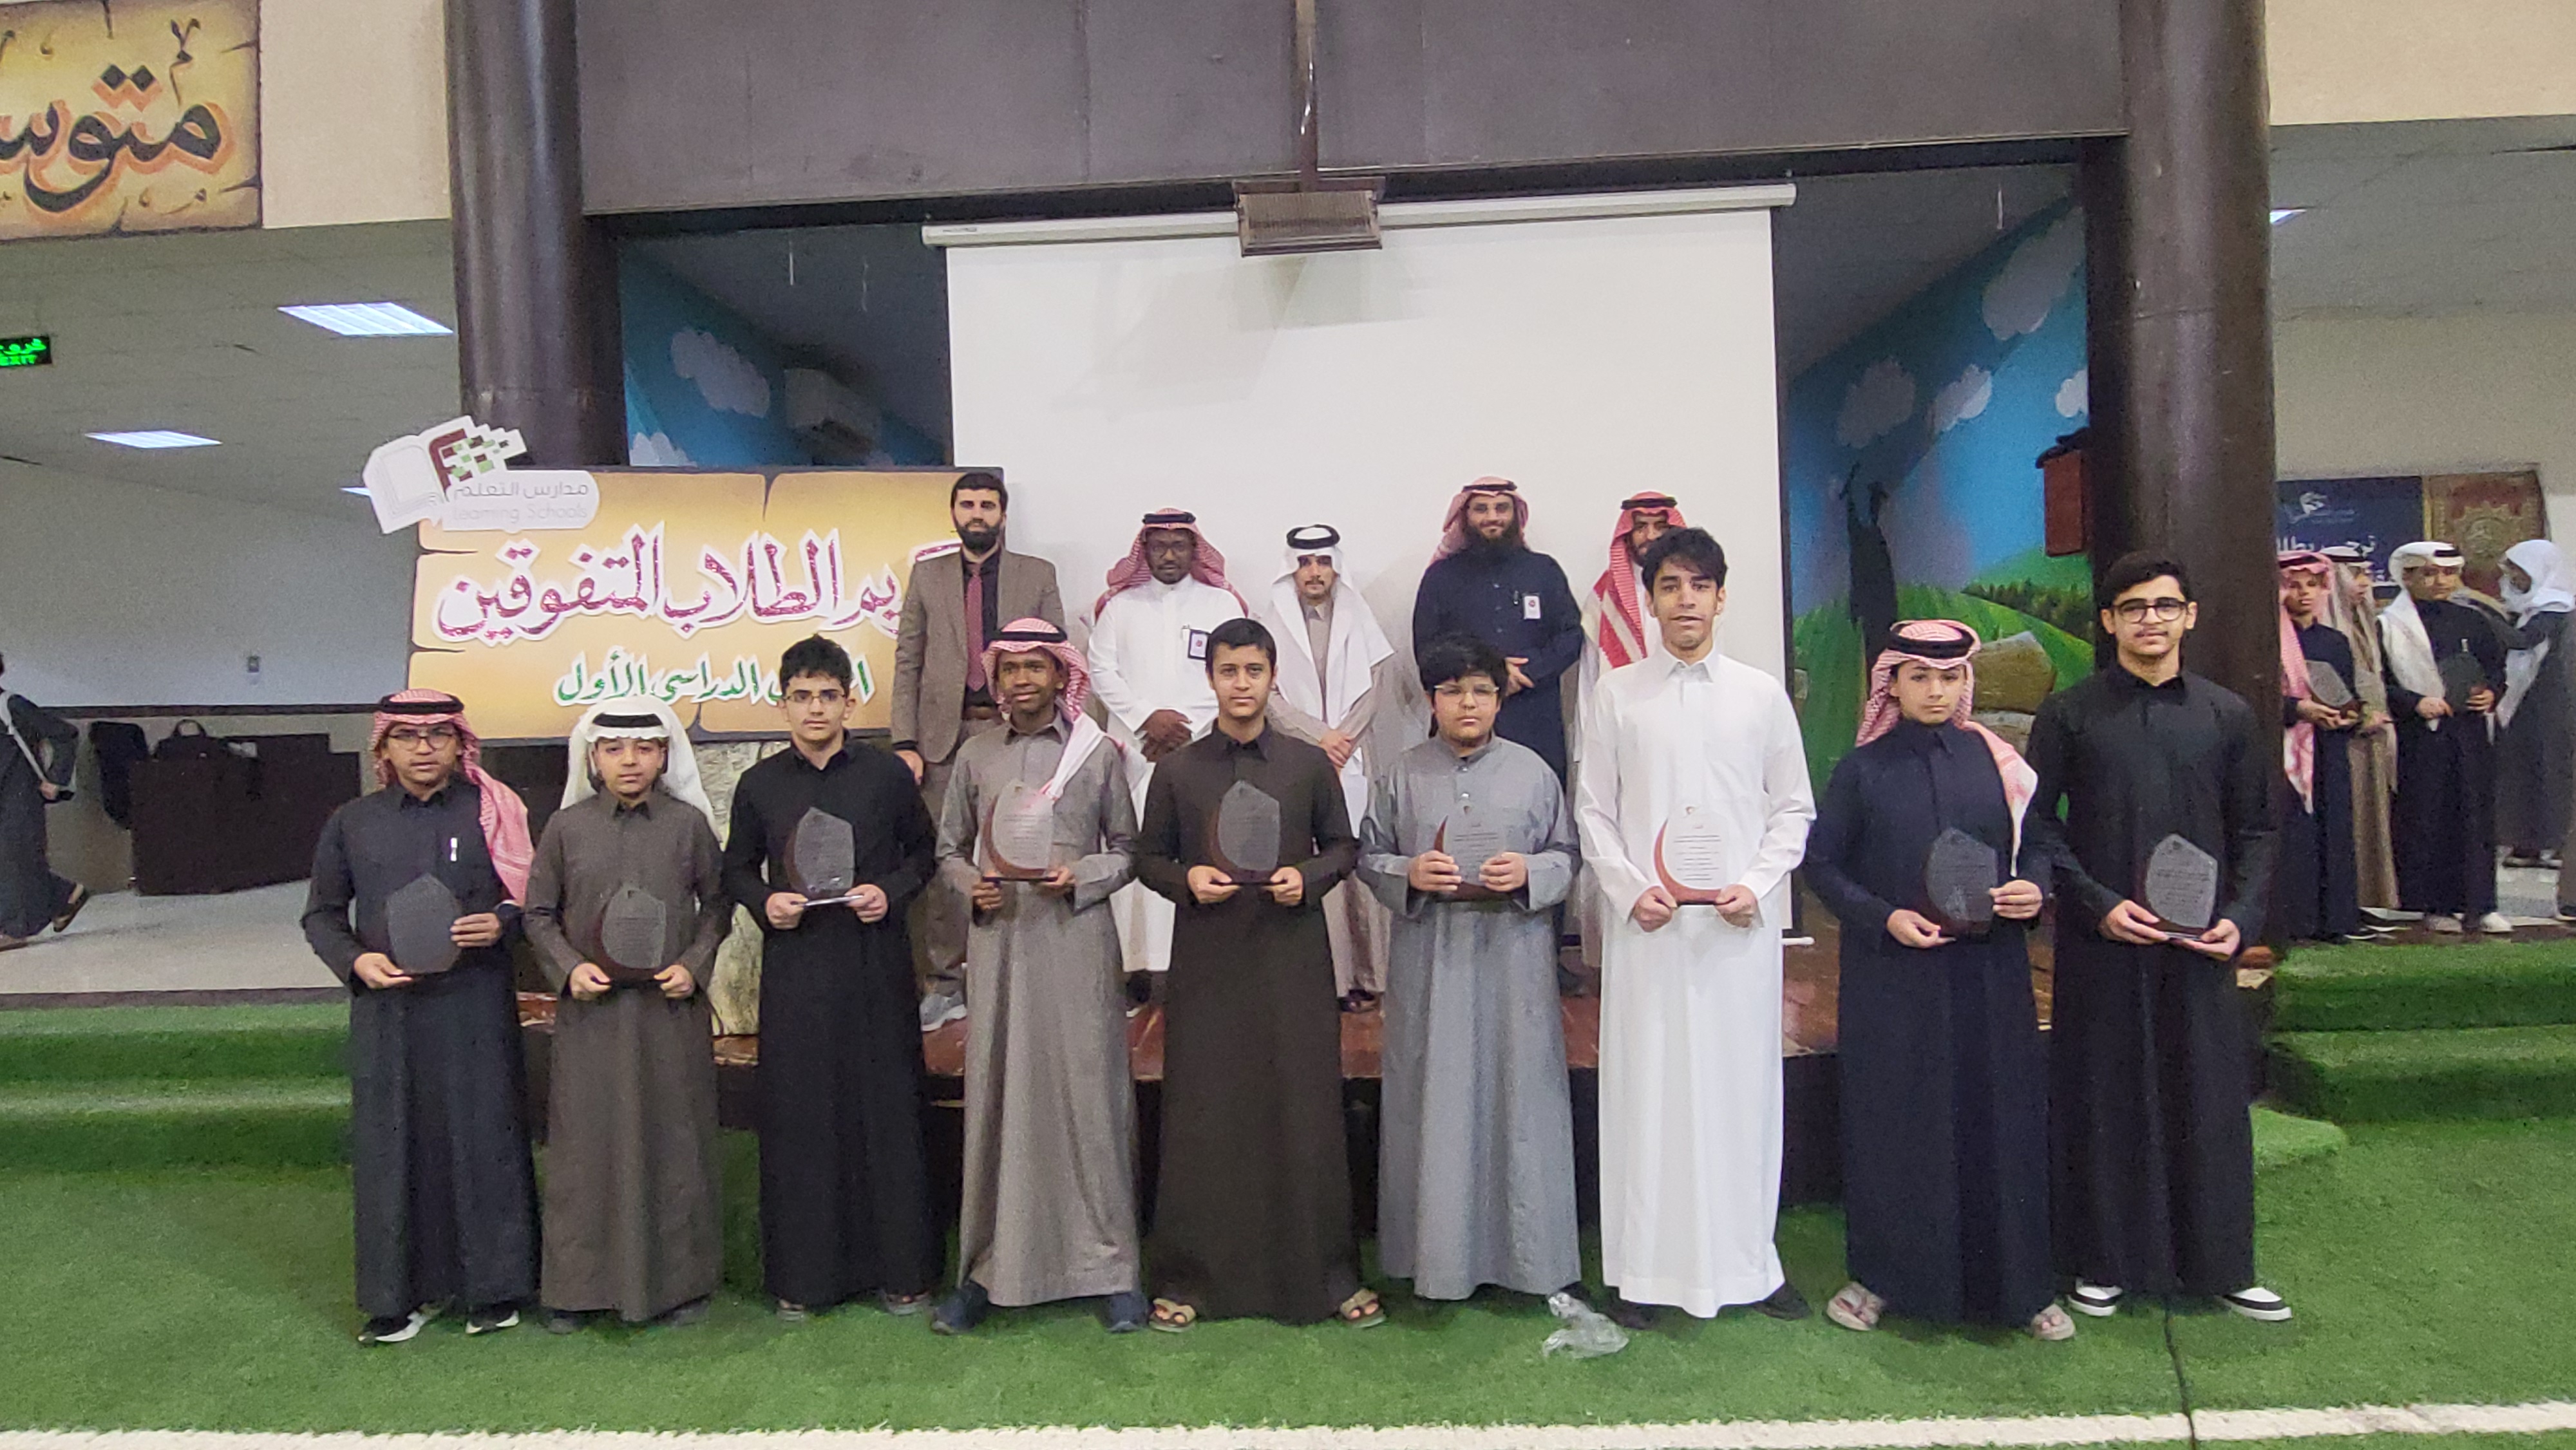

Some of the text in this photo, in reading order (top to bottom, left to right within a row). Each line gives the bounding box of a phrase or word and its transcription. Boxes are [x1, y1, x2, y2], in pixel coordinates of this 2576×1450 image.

[0, 63, 231, 219] متوس
[453, 480, 589, 500] مدارس التعلم
[453, 502, 589, 524] Learning Schools
[437, 532, 661, 640] المتفوقين
[662, 537, 841, 634] الطلاب
[557, 649, 647, 702] الأول
